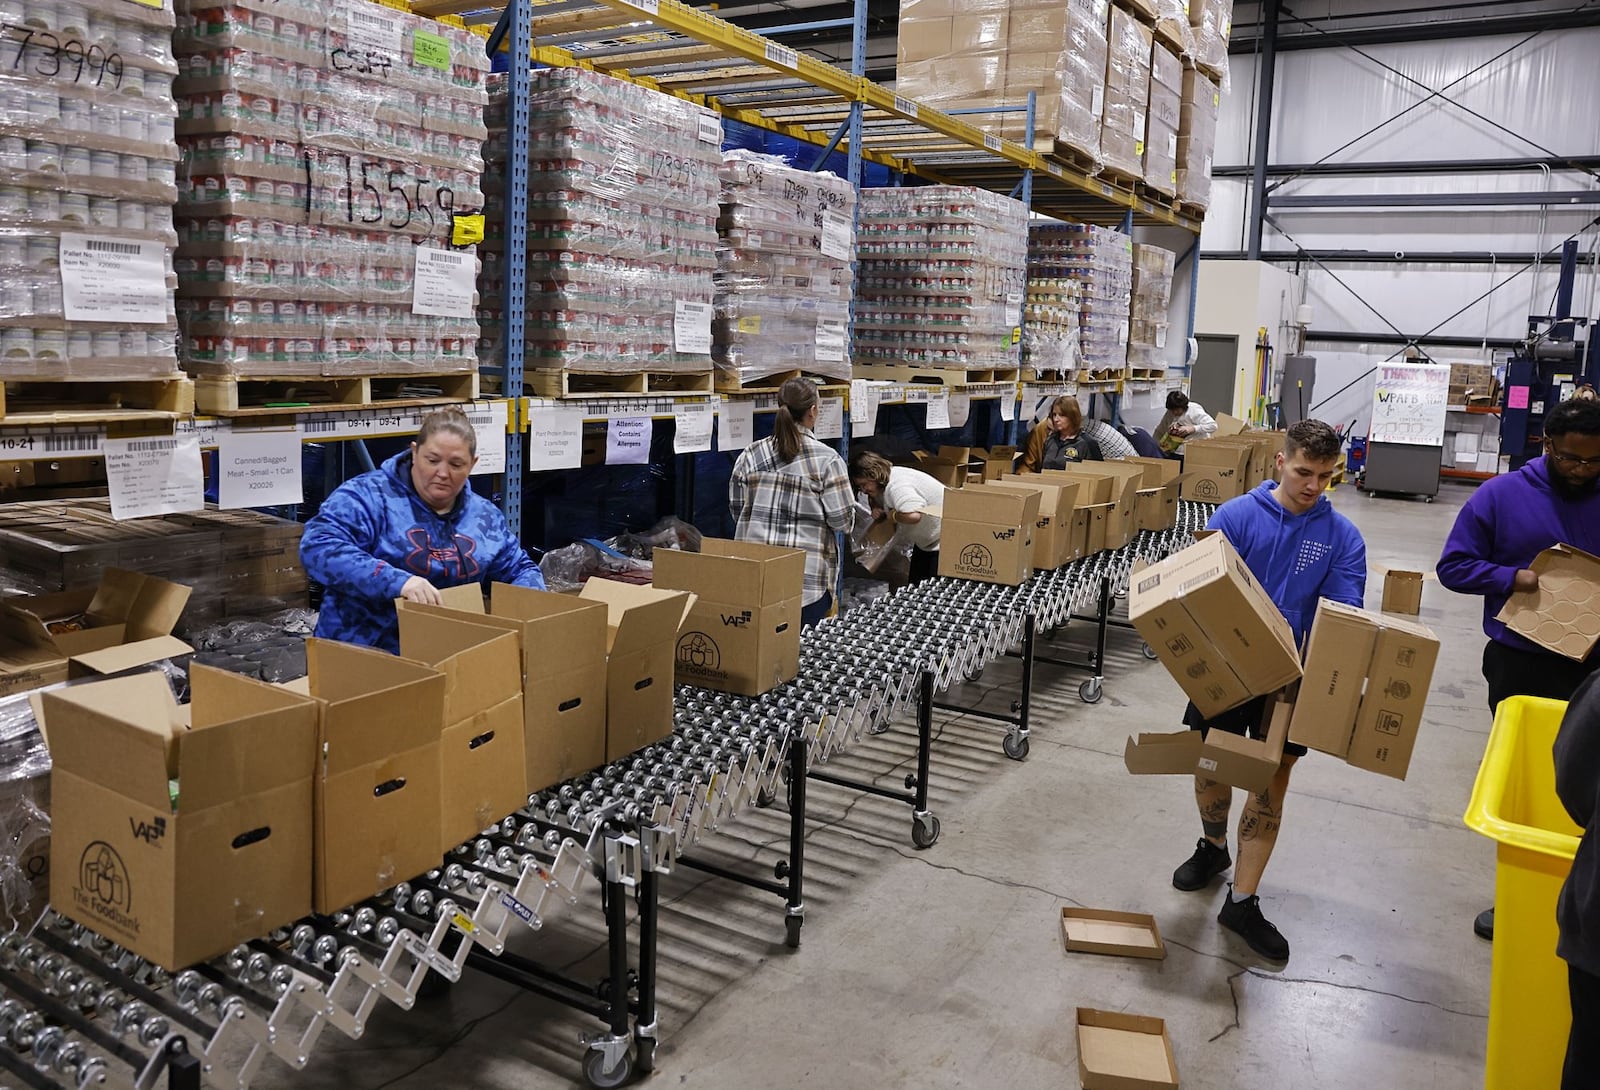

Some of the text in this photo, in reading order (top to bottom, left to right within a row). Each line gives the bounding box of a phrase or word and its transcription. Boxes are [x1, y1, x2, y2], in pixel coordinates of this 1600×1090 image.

[1381, 367, 1447, 384] THANK YOU
[1378, 392, 1418, 404] WPAFB
[348, 418, 365, 428] D9-1
[379, 416, 397, 426] D9-2
[617, 440, 641, 448] Allergens
[234, 456, 288, 466] Canned/Bagged
[227, 470, 244, 478] Meat
[250, 468, 268, 477] Small
[280, 467, 294, 476] Can
[967, 566, 998, 576] Foodbank
[685, 664, 729, 680] Foodbank
[72, 886, 88, 905] The
[91, 896, 140, 932] Foodbank
